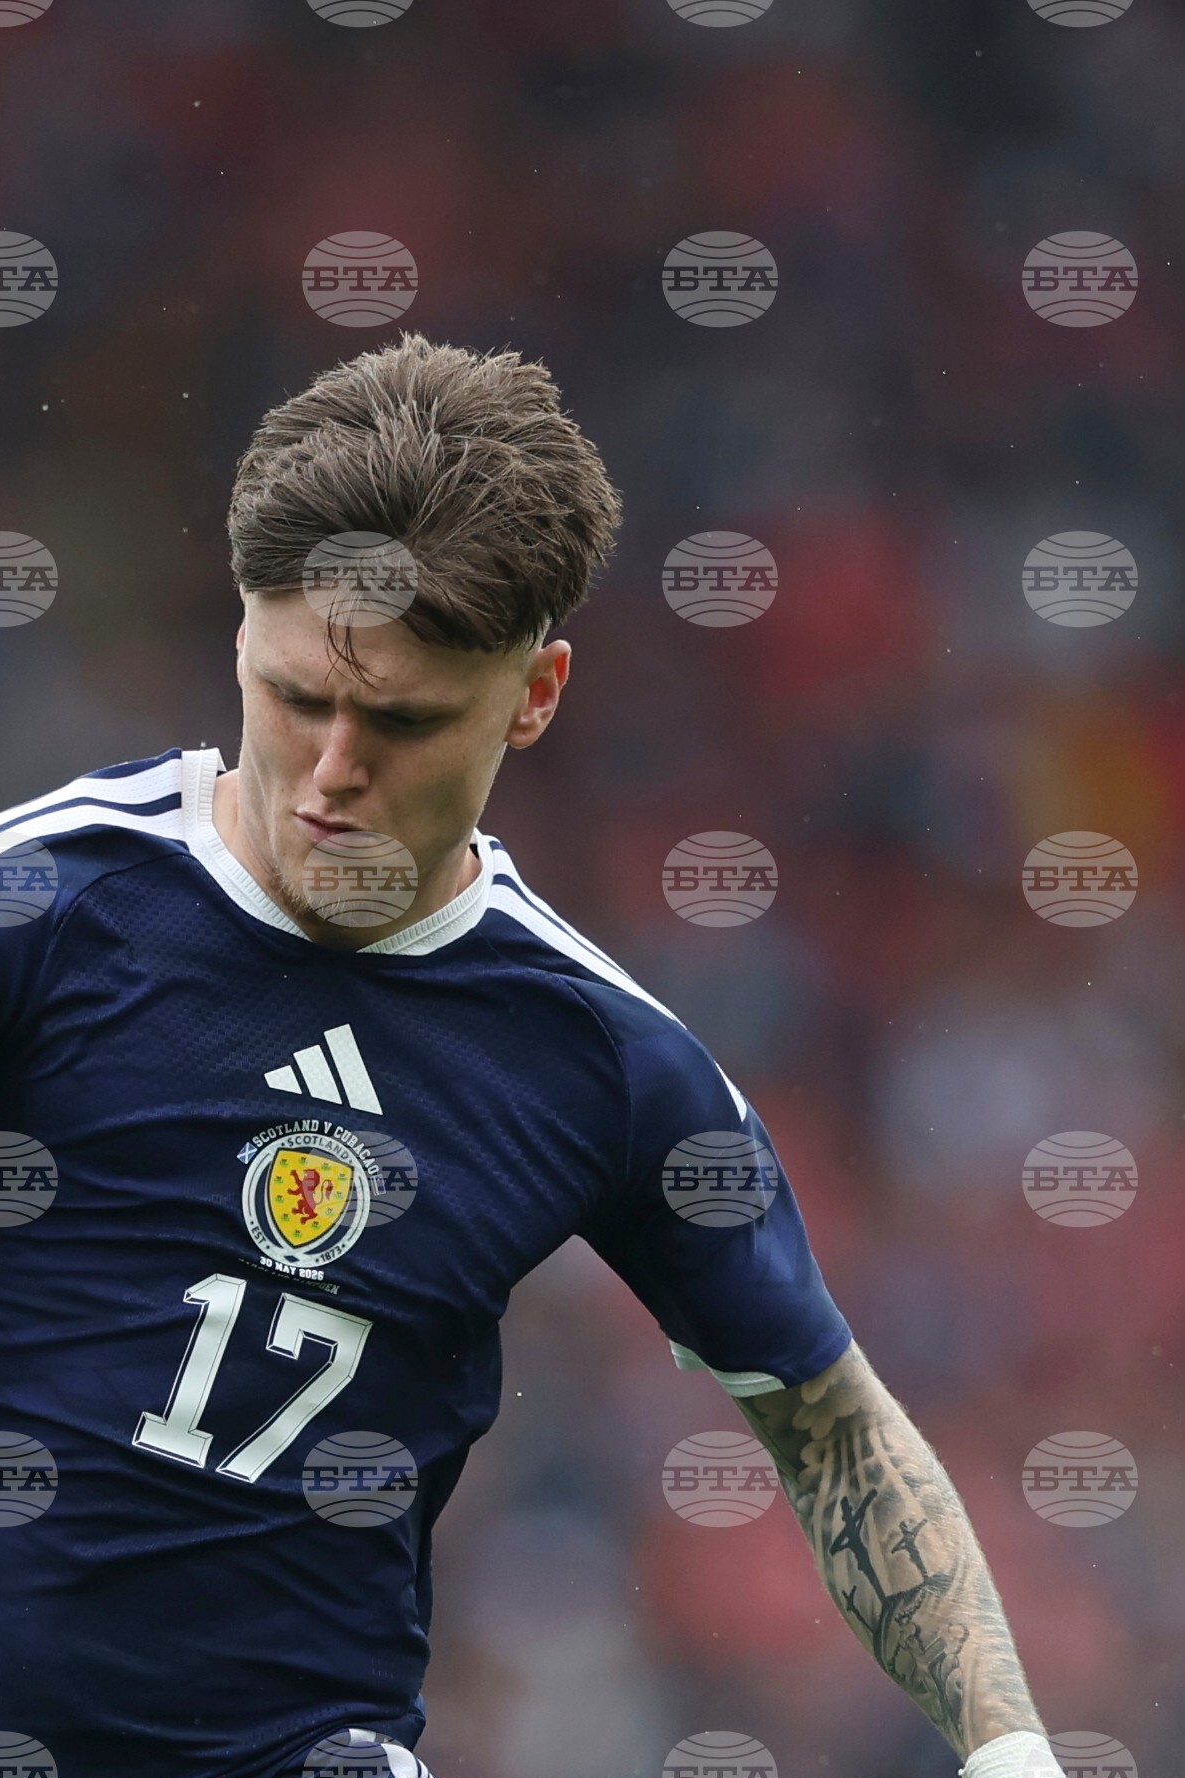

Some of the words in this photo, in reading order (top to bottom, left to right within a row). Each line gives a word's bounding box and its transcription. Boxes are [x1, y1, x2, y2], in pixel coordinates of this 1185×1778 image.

[252, 1119, 319, 1148] SCOTLAND
[323, 1121, 333, 1134] V
[287, 1135, 349, 1160] SCOTLAND
[251, 1226, 267, 1244] EST
[320, 1245, 343, 1262] 1873
[260, 1256, 273, 1267] 30
[275, 1262, 297, 1275] MAY
[299, 1268, 325, 1281] 2026
[132, 1273, 374, 1484] 17
